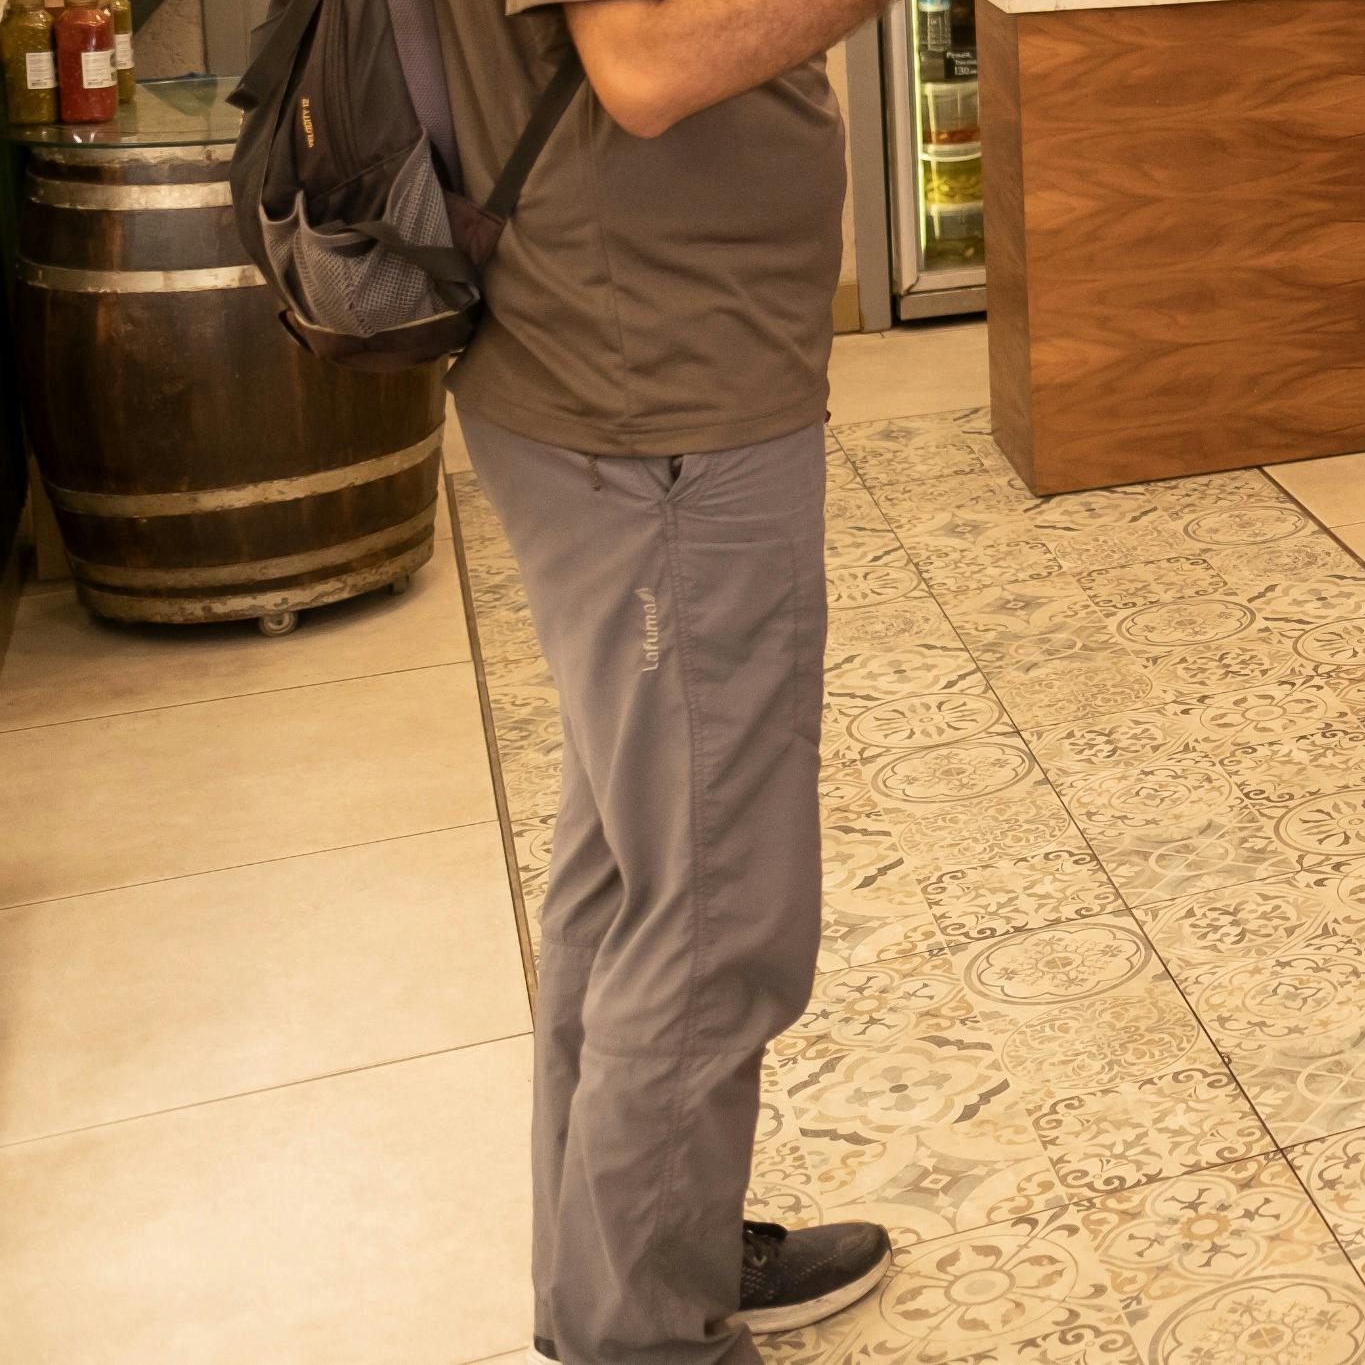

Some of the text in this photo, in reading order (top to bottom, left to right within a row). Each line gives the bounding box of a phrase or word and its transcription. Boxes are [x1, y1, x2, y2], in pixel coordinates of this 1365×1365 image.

[302, 98, 315, 148] VELOCITY 12
[642, 598, 660, 673] Lafuma
